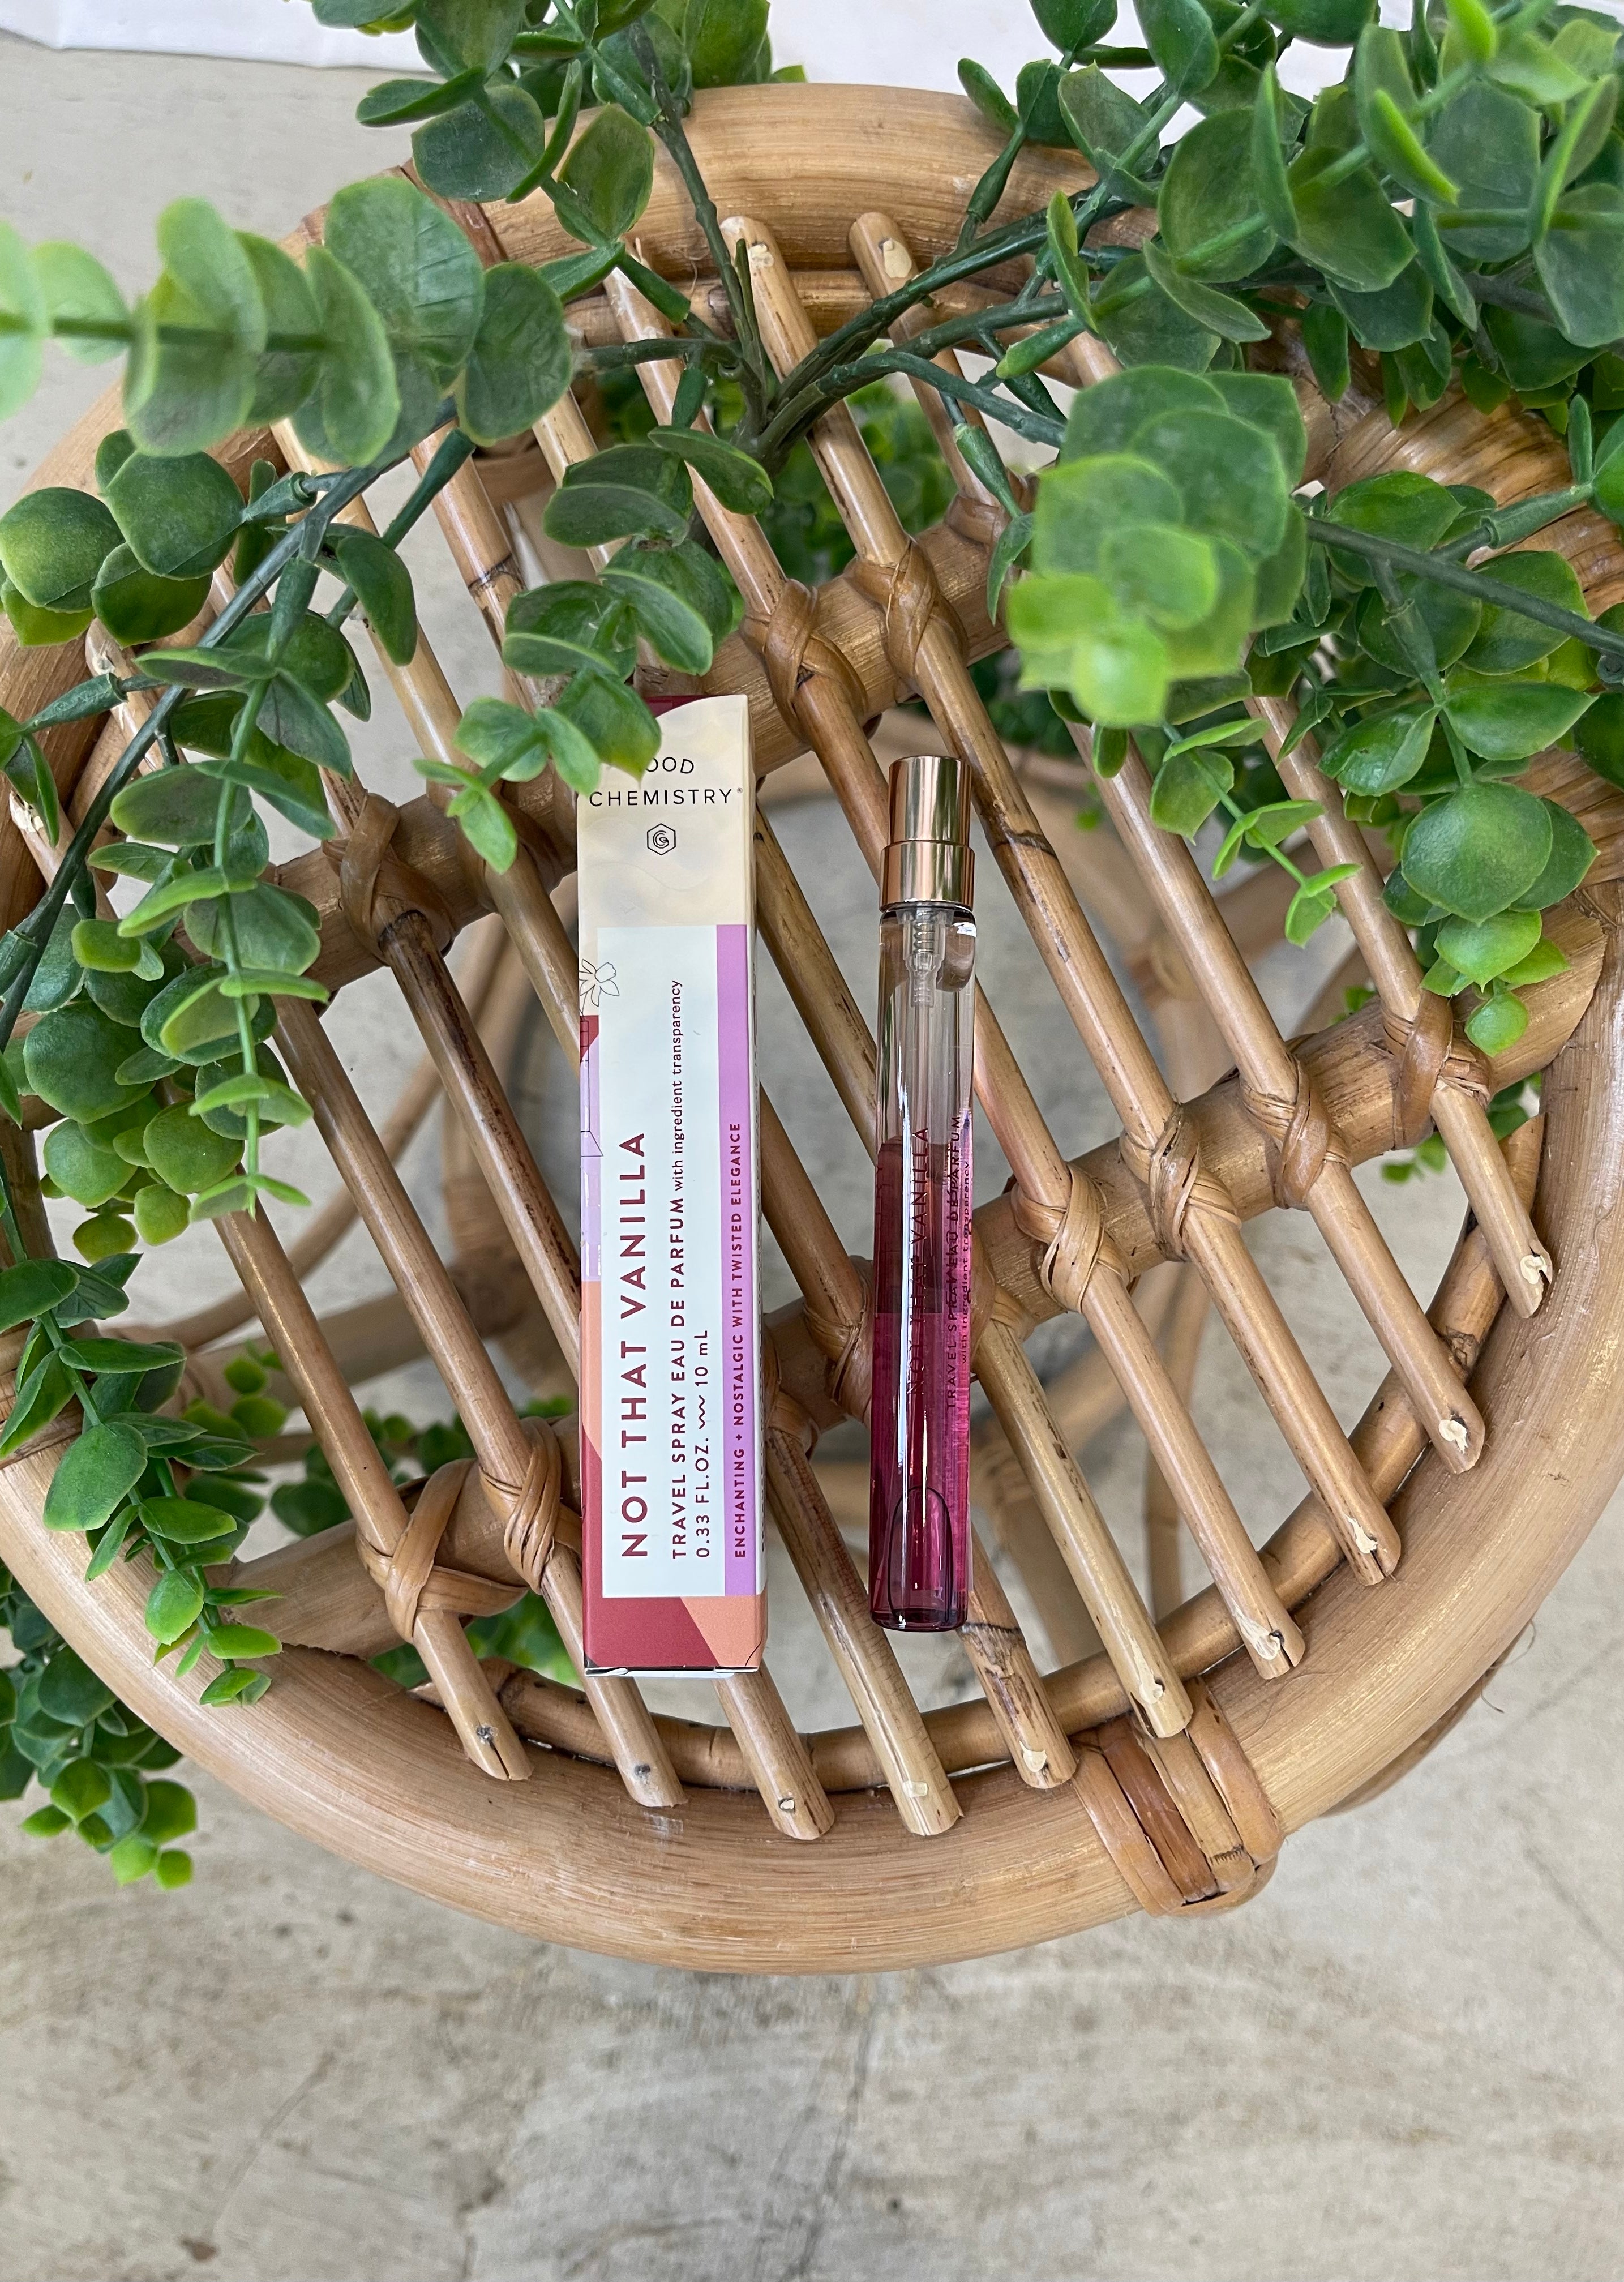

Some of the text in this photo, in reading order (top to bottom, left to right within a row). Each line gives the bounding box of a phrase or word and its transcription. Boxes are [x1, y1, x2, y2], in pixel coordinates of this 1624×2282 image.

[646, 757, 694, 774] OOD
[730, 1124, 742, 1205] ELEGANCE
[951, 1116, 961, 1189] PARFUM
[670, 980, 687, 1560] TRAVEL SPRAY EAU DE PARFUM with ingredient transparency
[731, 1213, 742, 1281] TWISTED
[907, 1128, 928, 1394] NOT THAT VANILLA
[619, 1133, 648, 1557] NOT THAT VANILLA
[732, 1288, 743, 1328] WITH
[732, 1335, 744, 1425] NOSTALGIC
[946, 1342, 957, 1408] TRAVEL
[693, 1330, 710, 1558] 0.33 FL.OZ. 10 mL
[734, 1449, 745, 1557] ENCHANTING
